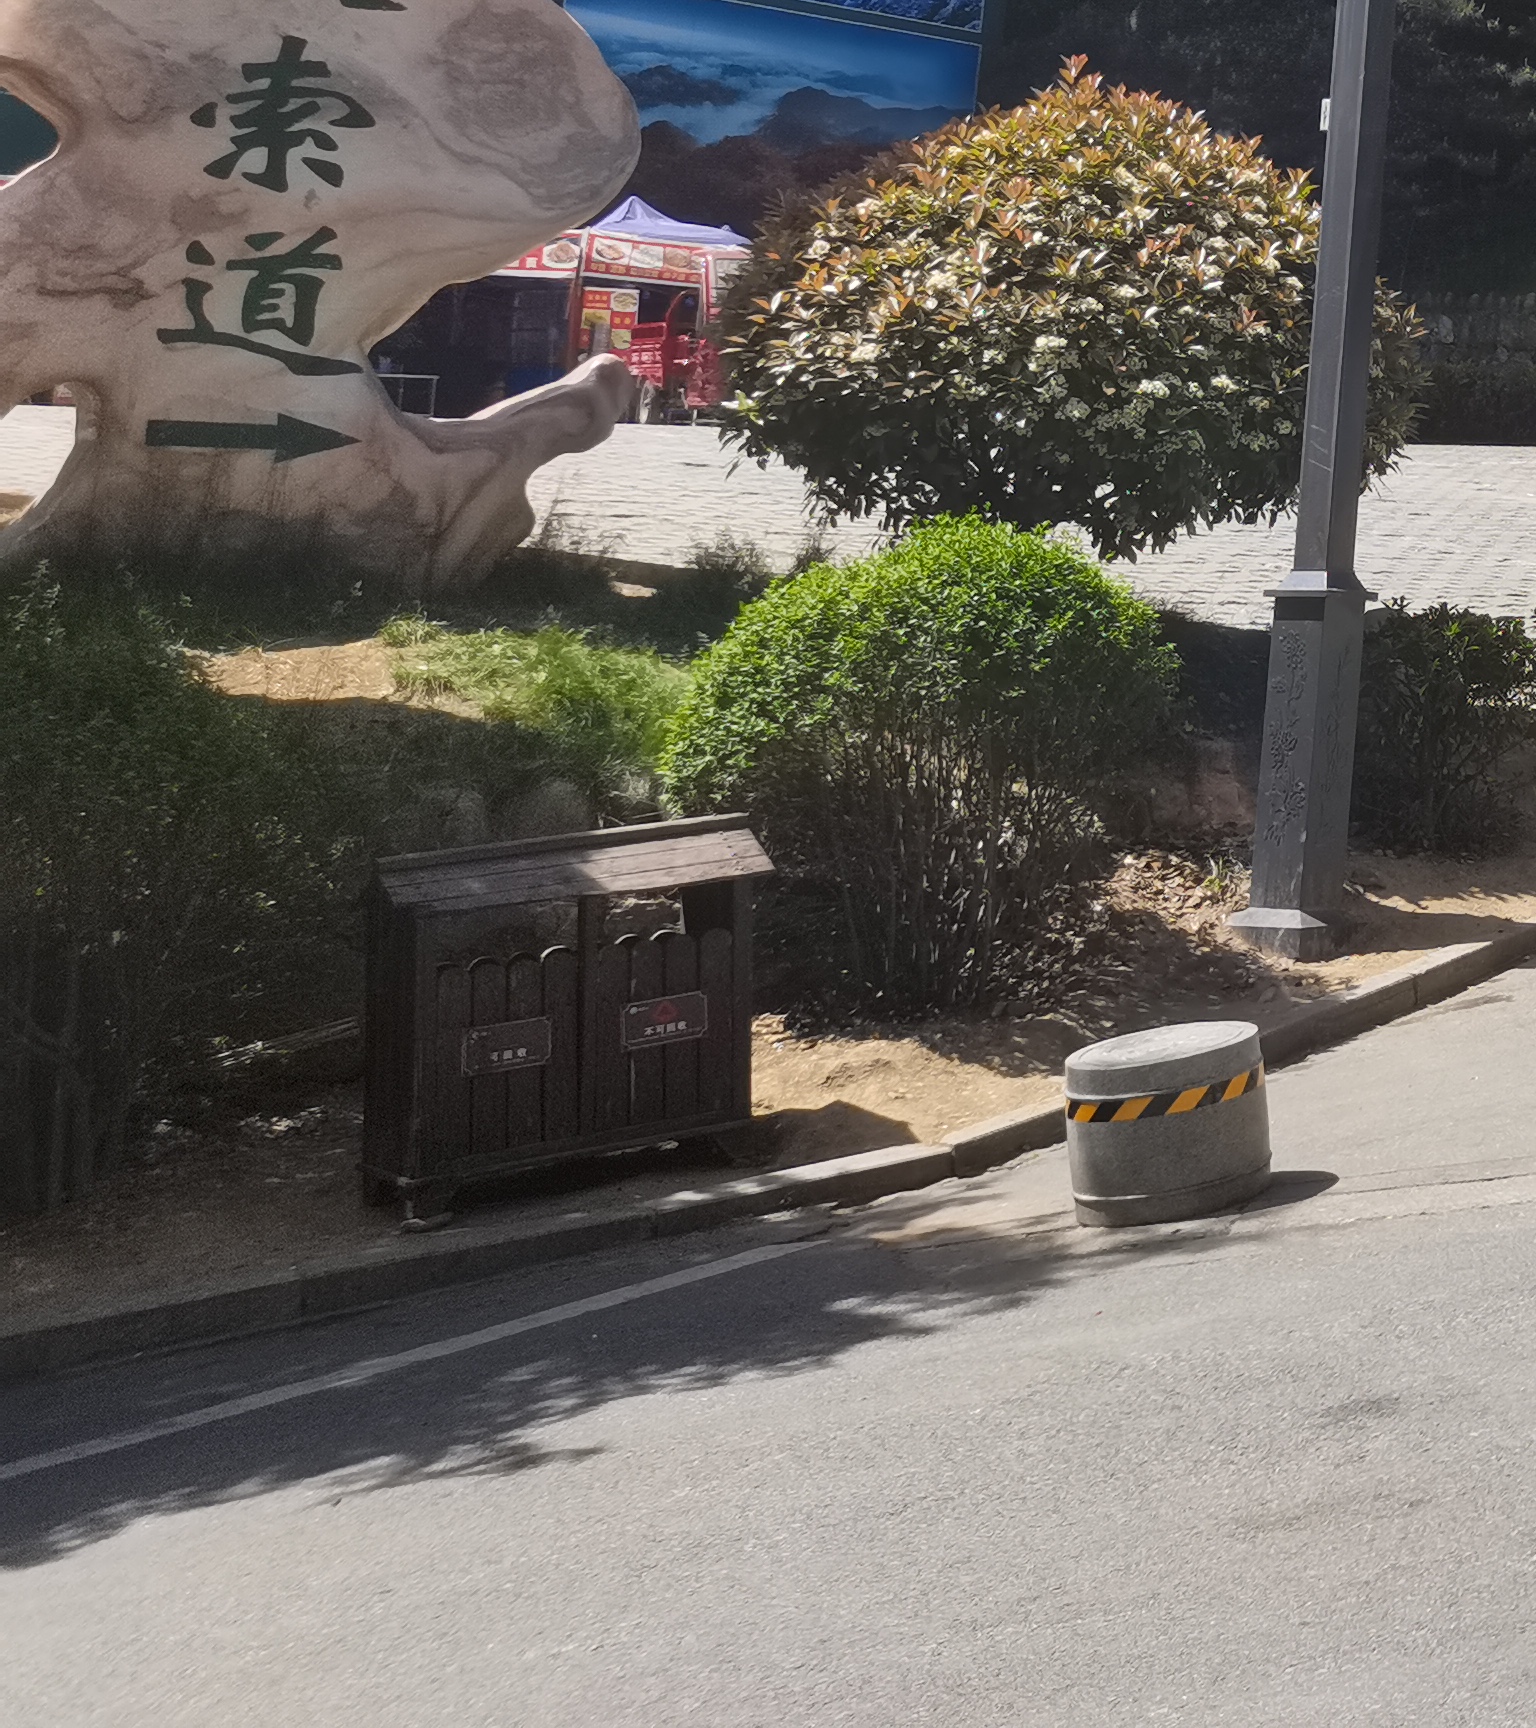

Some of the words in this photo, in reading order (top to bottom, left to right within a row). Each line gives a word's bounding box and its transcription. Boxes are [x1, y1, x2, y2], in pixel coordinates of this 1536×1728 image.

[644, 1020, 687, 1036] 不可回收
[490, 1047, 527, 1062] 可回收
